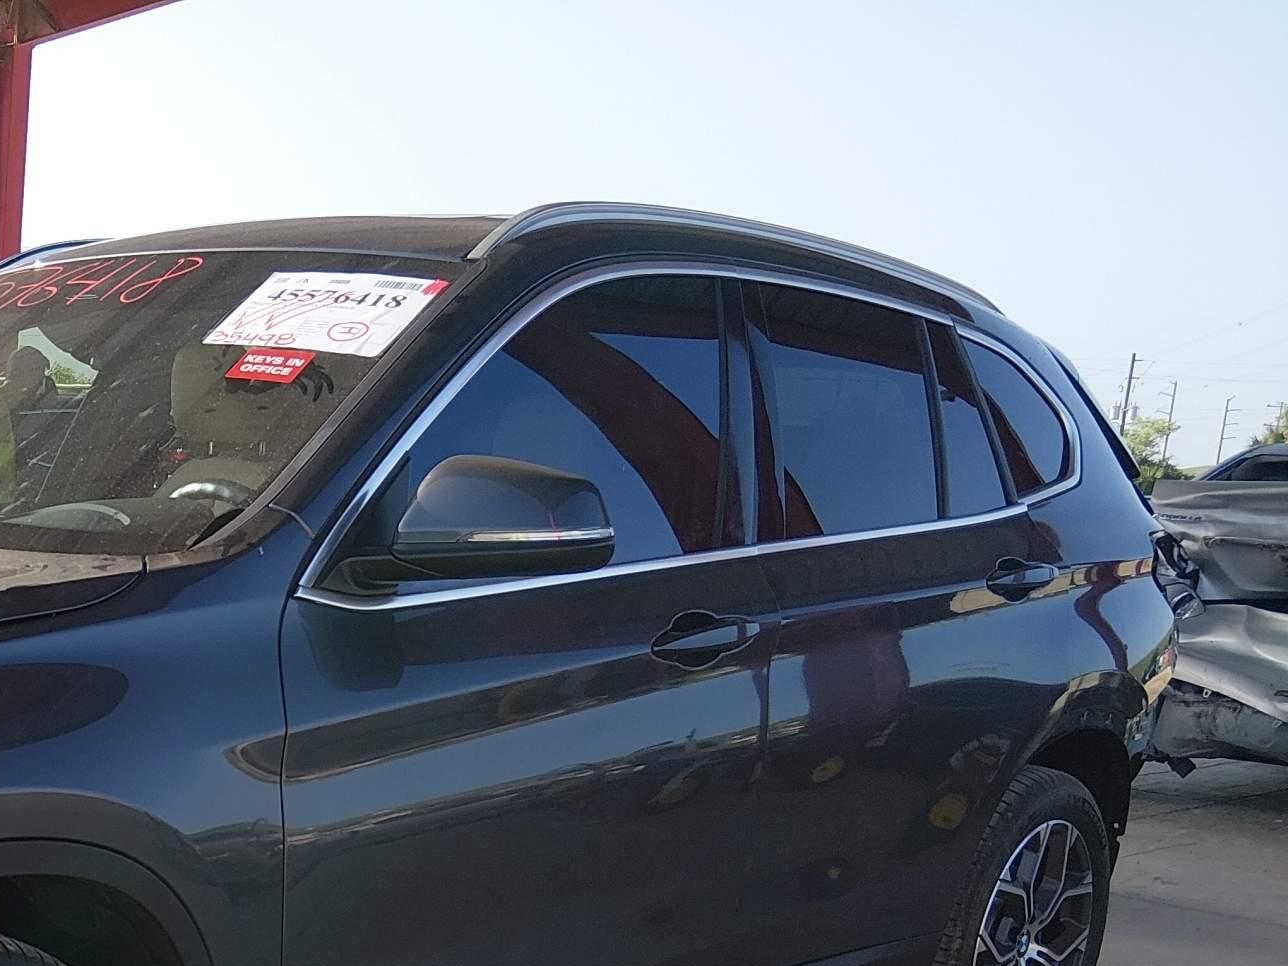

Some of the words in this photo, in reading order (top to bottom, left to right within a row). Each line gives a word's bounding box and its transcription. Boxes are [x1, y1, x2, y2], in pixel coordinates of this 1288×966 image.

[267, 288, 408, 309] 45576418
[243, 354, 285, 365] KEYS
[285, 358, 305, 367] IN
[239, 363, 294, 376] OFFICE
